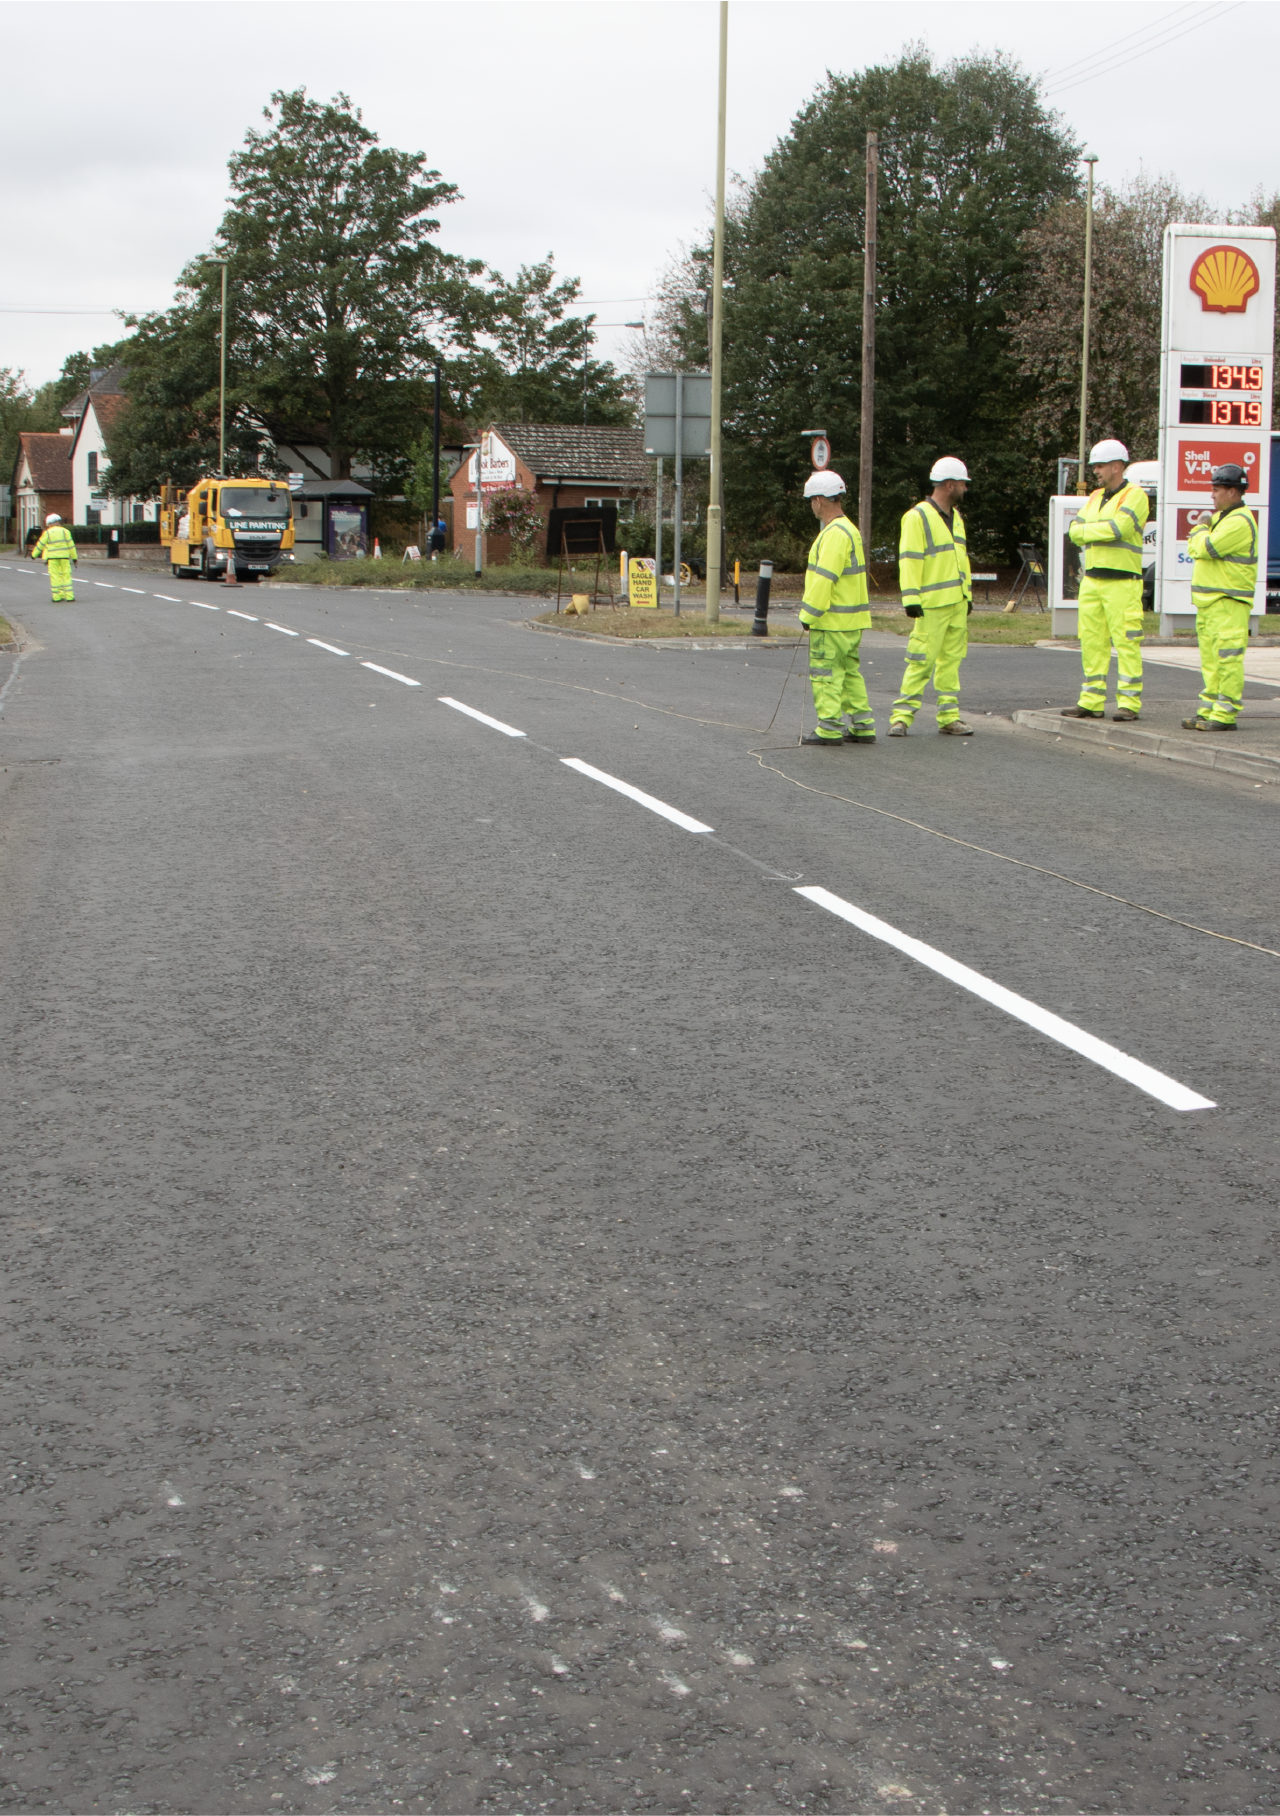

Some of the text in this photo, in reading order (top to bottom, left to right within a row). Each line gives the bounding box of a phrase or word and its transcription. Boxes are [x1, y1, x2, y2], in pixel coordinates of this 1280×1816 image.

[1211, 365, 1263, 389] 134.9
[1210, 400, 1262, 425] 137.9
[1184, 450, 1210, 461] Shell
[1184, 461, 1250, 475] V-Por
[229, 521, 287, 529] LINE PAINTING
